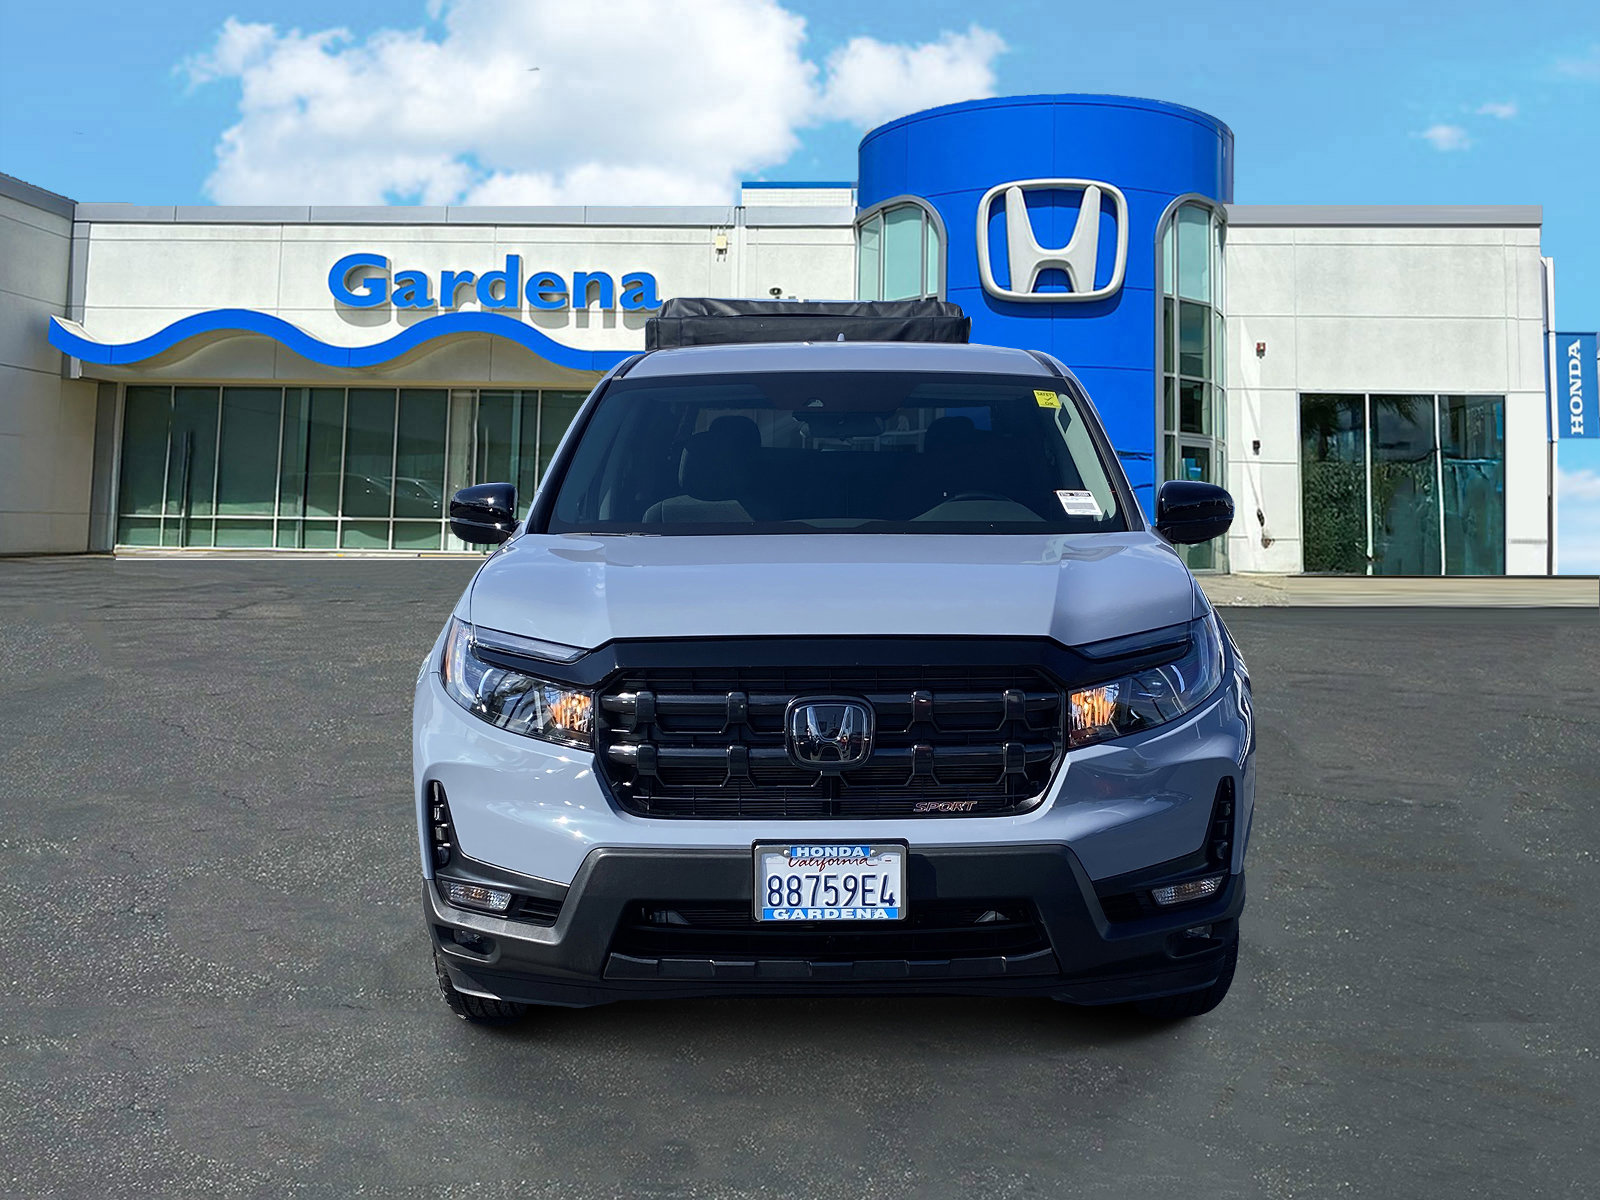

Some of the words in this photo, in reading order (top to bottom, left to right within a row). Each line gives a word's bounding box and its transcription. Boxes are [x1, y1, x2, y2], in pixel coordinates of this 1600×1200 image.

[328, 253, 663, 310] Gardena
[1568, 339, 1583, 434] HONDA
[913, 800, 978, 812] SPORT
[796, 846, 865, 857] HONDA
[767, 874, 896, 907] 88759E4
[772, 908, 889, 920] GARDENA
